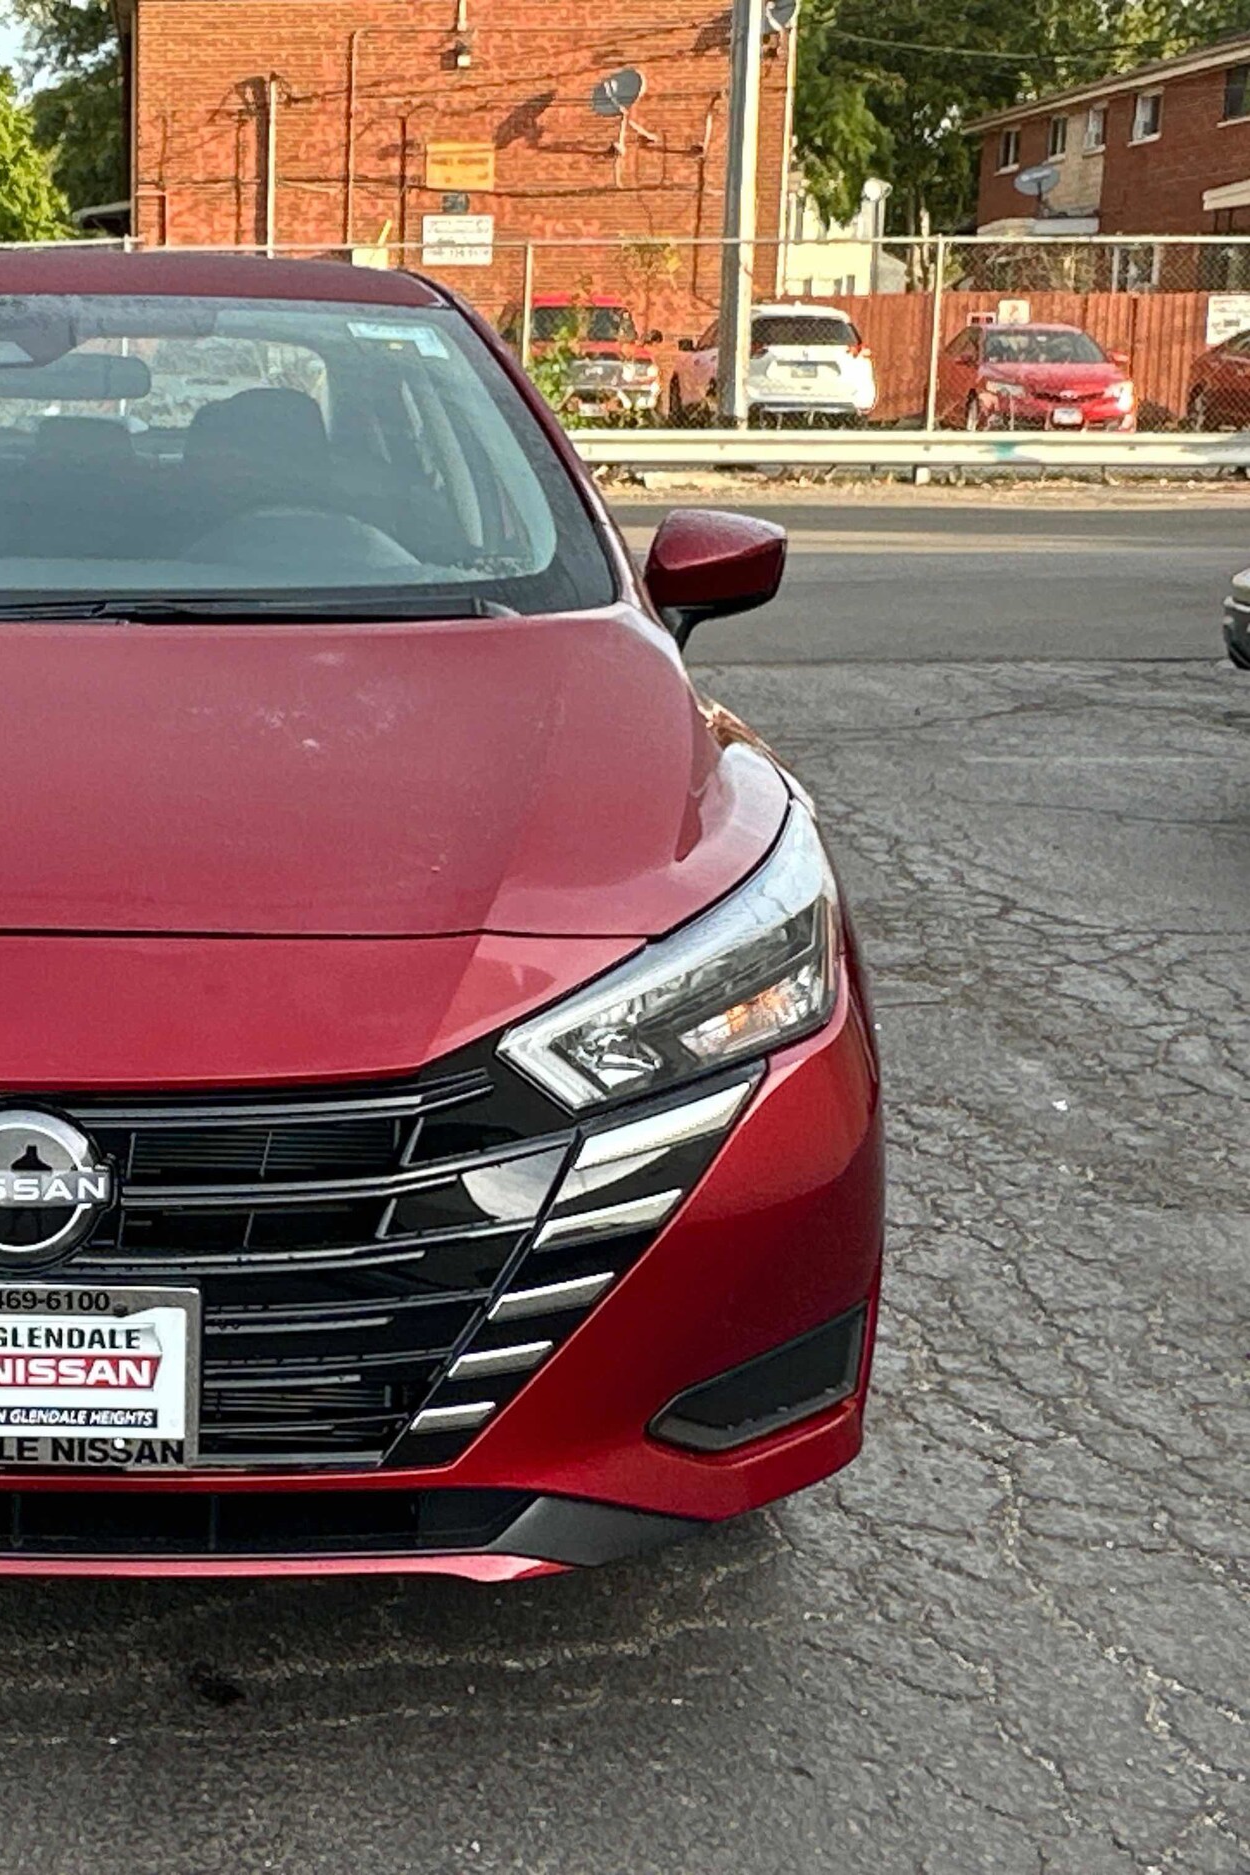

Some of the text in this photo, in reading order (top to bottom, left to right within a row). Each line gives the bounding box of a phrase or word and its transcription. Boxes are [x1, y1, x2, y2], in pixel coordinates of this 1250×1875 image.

[9, 1408, 87, 1425] GLENDALE
[89, 1410, 153, 1427] HEIGHTS
[51, 1438, 185, 1464] NISSAN
